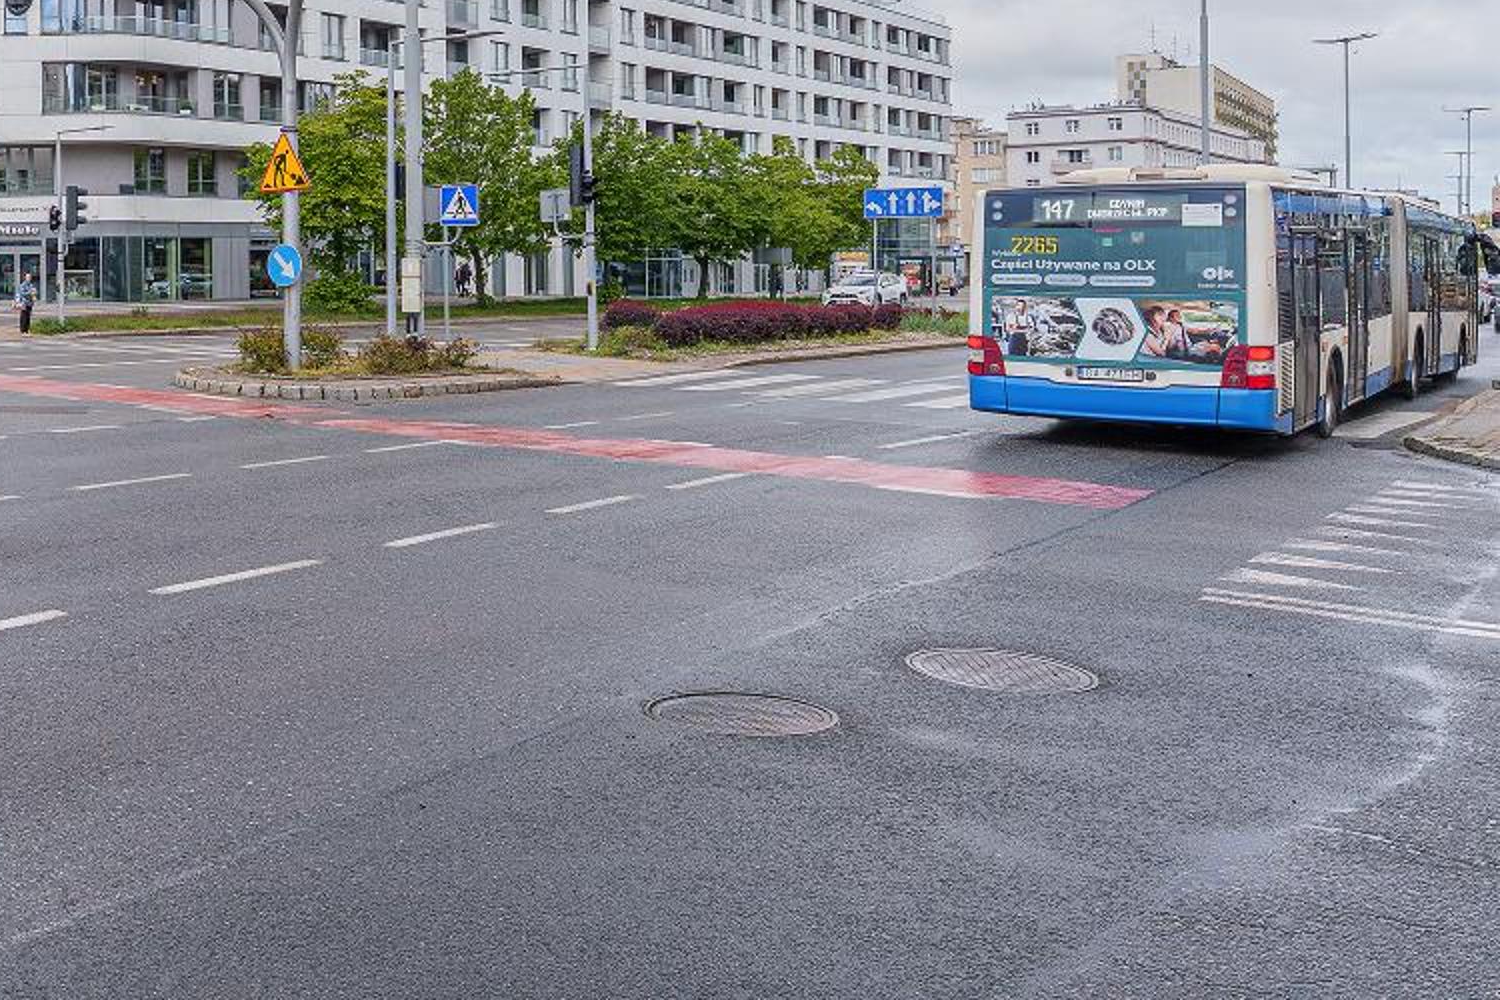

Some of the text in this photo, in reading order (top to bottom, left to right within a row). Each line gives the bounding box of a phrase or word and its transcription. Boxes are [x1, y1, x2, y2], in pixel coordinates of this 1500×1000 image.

[1041, 199, 1075, 220] 147
[1011, 236, 1059, 254] 2265
[1035, 259, 1101, 272] Używane
[1103, 261, 1120, 270] na
[1123, 259, 1157, 271] OLX
